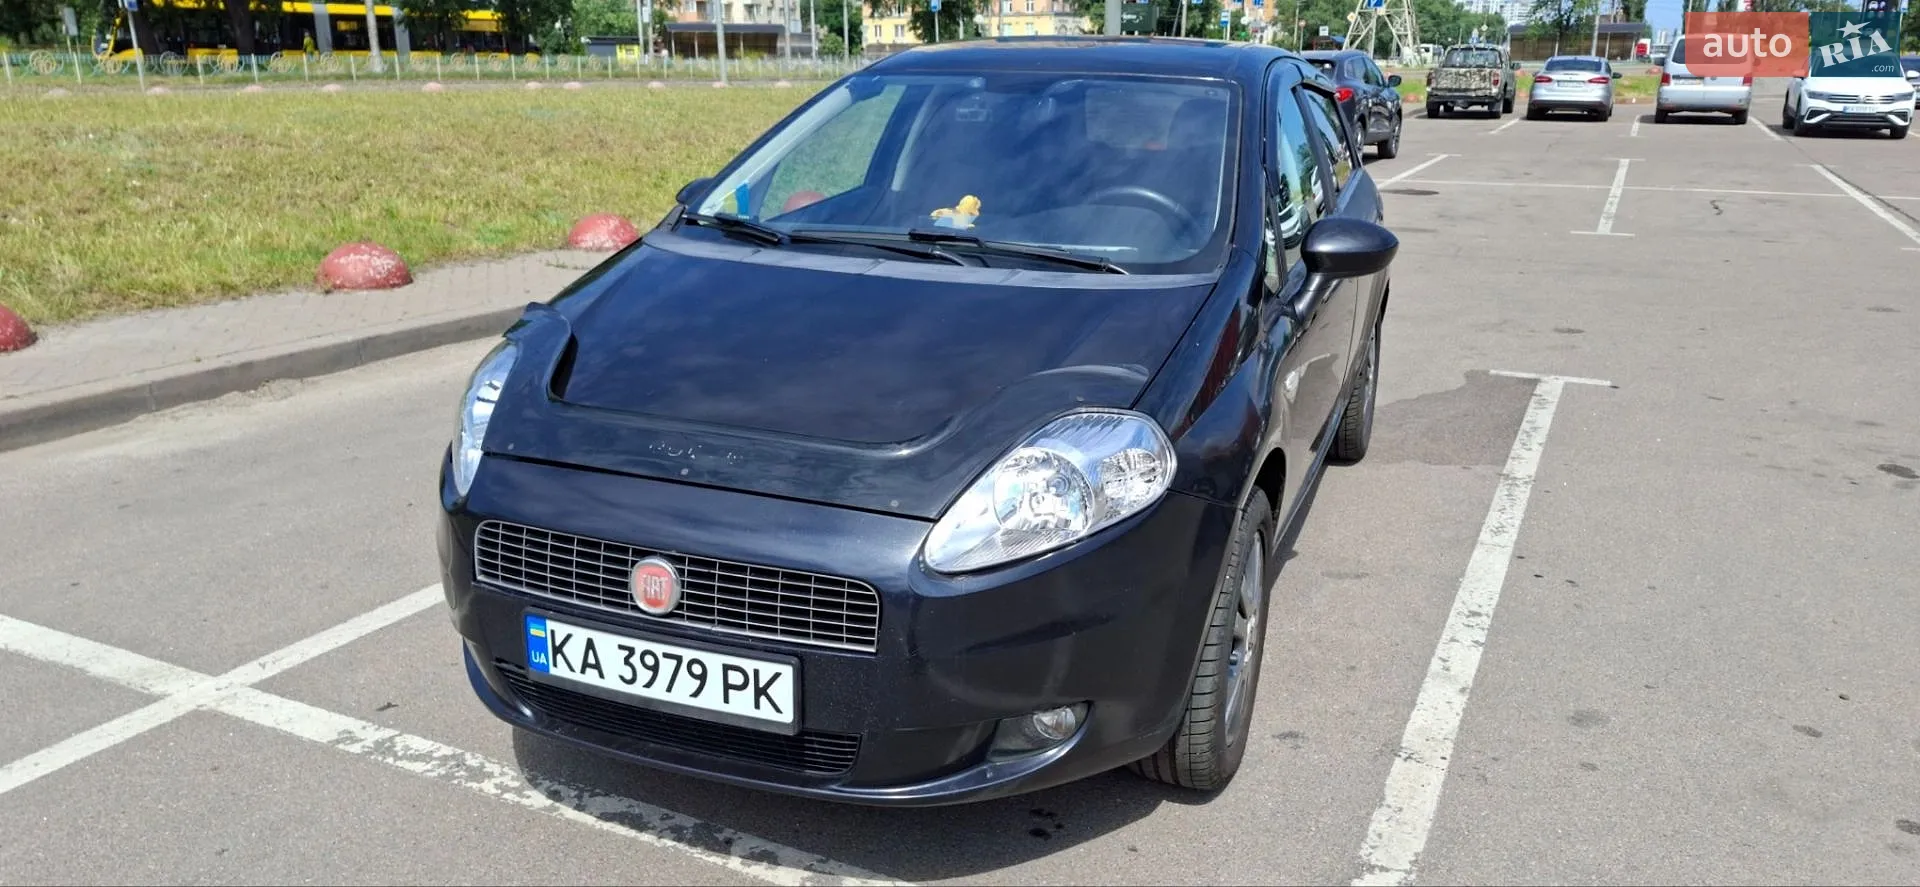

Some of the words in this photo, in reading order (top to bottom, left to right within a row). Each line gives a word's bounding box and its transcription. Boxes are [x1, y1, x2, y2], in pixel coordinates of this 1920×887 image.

[639, 573, 669, 600] FIAT
[531, 650, 548, 665] UA
[550, 629, 605, 680] KA
[617, 644, 709, 699] 3979
[721, 663, 784, 714] PK
